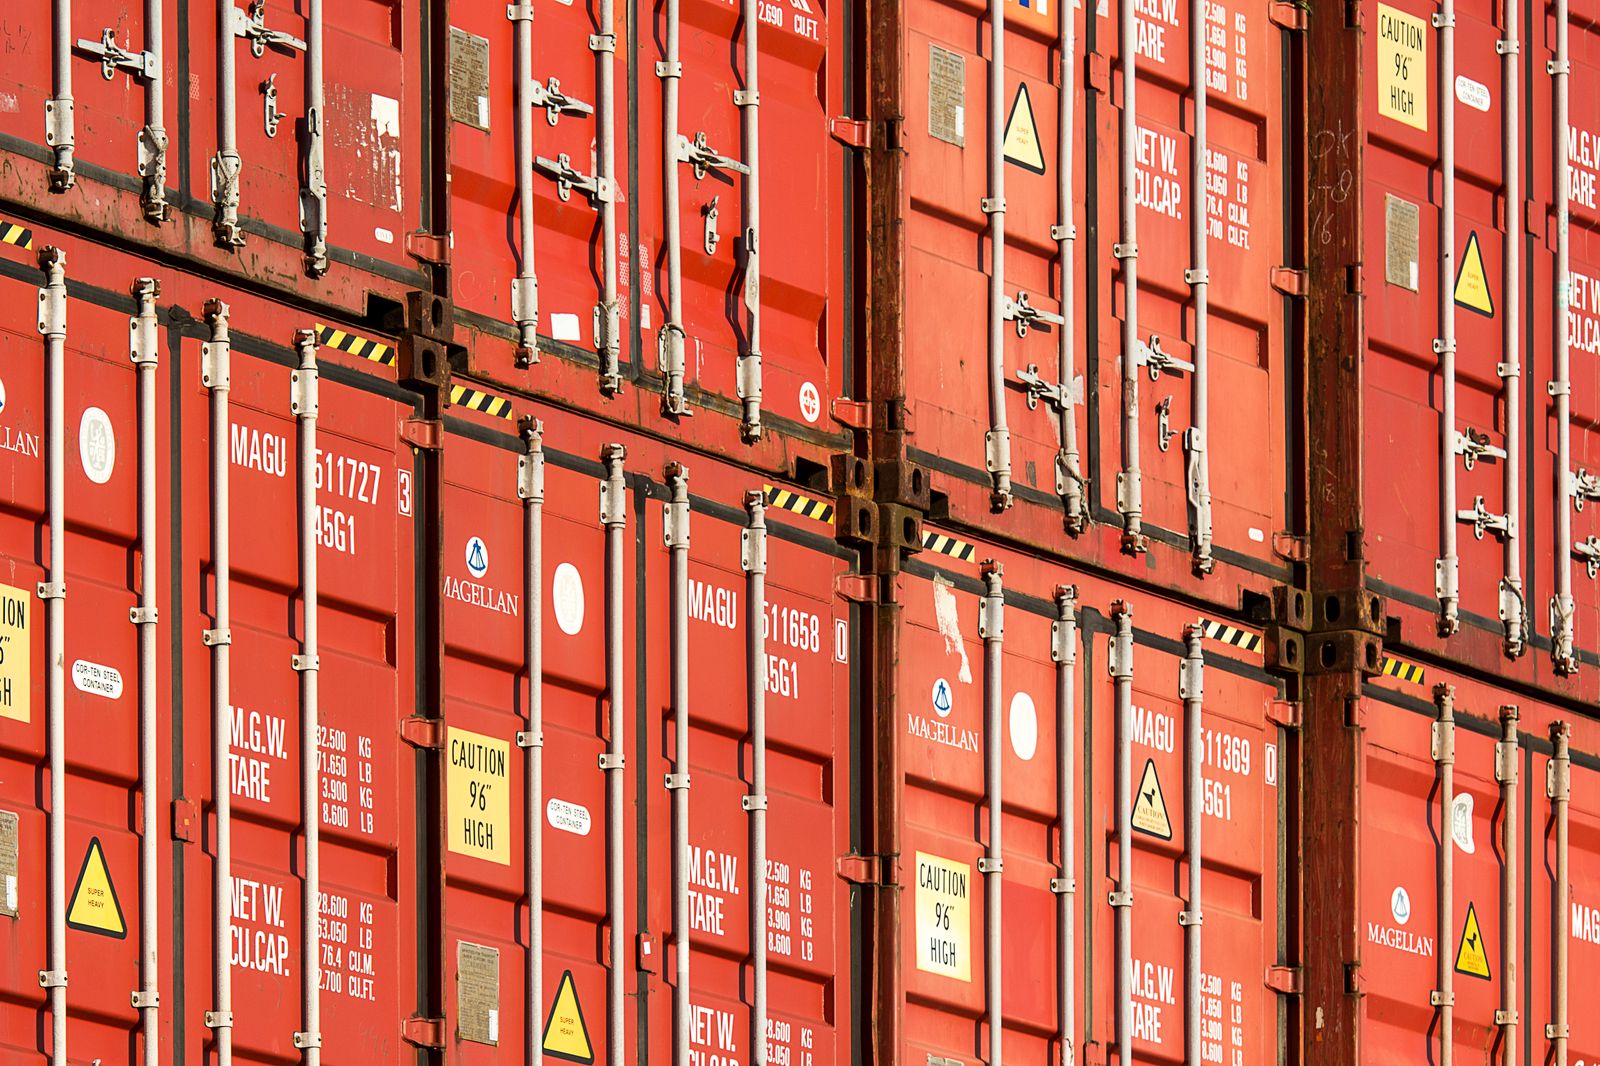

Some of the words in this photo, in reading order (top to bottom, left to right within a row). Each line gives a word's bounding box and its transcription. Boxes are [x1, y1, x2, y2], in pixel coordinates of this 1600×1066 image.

[793, 14, 819, 41] CU.FT.
[1235, 12, 1246, 34] KG
[1381, 14, 1422, 52] CAUTION
[1134, 16, 1165, 64] TARE
[1235, 34, 1246, 56] LB
[1235, 57, 1247, 79] KG
[1236, 79, 1247, 101] LB
[1390, 85, 1414, 116] HIGH
[1135, 124, 1158, 168] NET
[1160, 134, 1178, 176] W.
[1237, 160, 1248, 182] KG
[1134, 167, 1182, 220] CU.CAP.
[1237, 183, 1248, 204] LB
[1568, 166, 1597, 209] TARE
[1228, 202, 1250, 228] CU.M.
[1228, 225, 1250, 250] CU.FT.
[1568, 270, 1589, 310] NET
[231, 423, 286, 478] MAGU
[315, 448, 381, 505] 511727
[399, 472, 410, 513] 3
[315, 504, 355, 555] 45G1
[443, 575, 519, 617] MAGELLAN
[688, 578, 737, 629] MAGU
[764, 601, 820, 653] 511658
[75, 662, 101, 678] COR-TEN
[103, 667, 121, 683] STEEL
[82, 677, 114, 694] CONTAINER
[229, 705, 287, 760] M.G.W.
[907, 713, 979, 753] MAGELLAN
[1131, 704, 1174, 753] MAGU
[358, 736, 372, 758] KG
[451, 739, 505, 778] CAUTION
[229, 753, 271, 803] TARE
[359, 761, 372, 783] LB
[359, 786, 373, 809] KG
[360, 811, 374, 834] LB
[464, 817, 493, 850] HIGH
[688, 844, 739, 895] M.G.W.
[800, 868, 812, 890] KG
[920, 862, 966, 899] CAUTION
[88, 887, 104, 897] SUPER
[88, 899, 104, 909] HEAVY
[229, 876, 260, 921] NET
[263, 883, 285, 928] W.
[800, 892, 812, 914] LB
[359, 901, 373, 924] KG
[688, 890, 725, 936] TARE
[359, 927, 373, 949] LB
[800, 916, 813, 938] KG
[1368, 922, 1433, 957] MAGELLAN
[229, 925, 290, 977] CU.CAP.
[322, 944, 342, 968] 76.4
[349, 950, 375, 976] CU.M.
[801, 940, 813, 961] LB
[930, 936, 956, 968] HIGH
[349, 975, 375, 1001] CU.FT.
[1130, 958, 1175, 1005] M.G.W.
[1231, 981, 1242, 1002] KG
[560, 1016, 574, 1026] SUPER
[1130, 1000, 1162, 1043] TARE
[1231, 1003, 1242, 1024] LB
[560, 1027, 574, 1036] HEAVY
[689, 1004, 714, 1046] NET
[717, 1010, 736, 1052] W.
[801, 1027, 813, 1048] KG
[1232, 1026, 1242, 1047] KG
[801, 1050, 813, 1066] LB
[1232, 1048, 1243, 1066] LB
